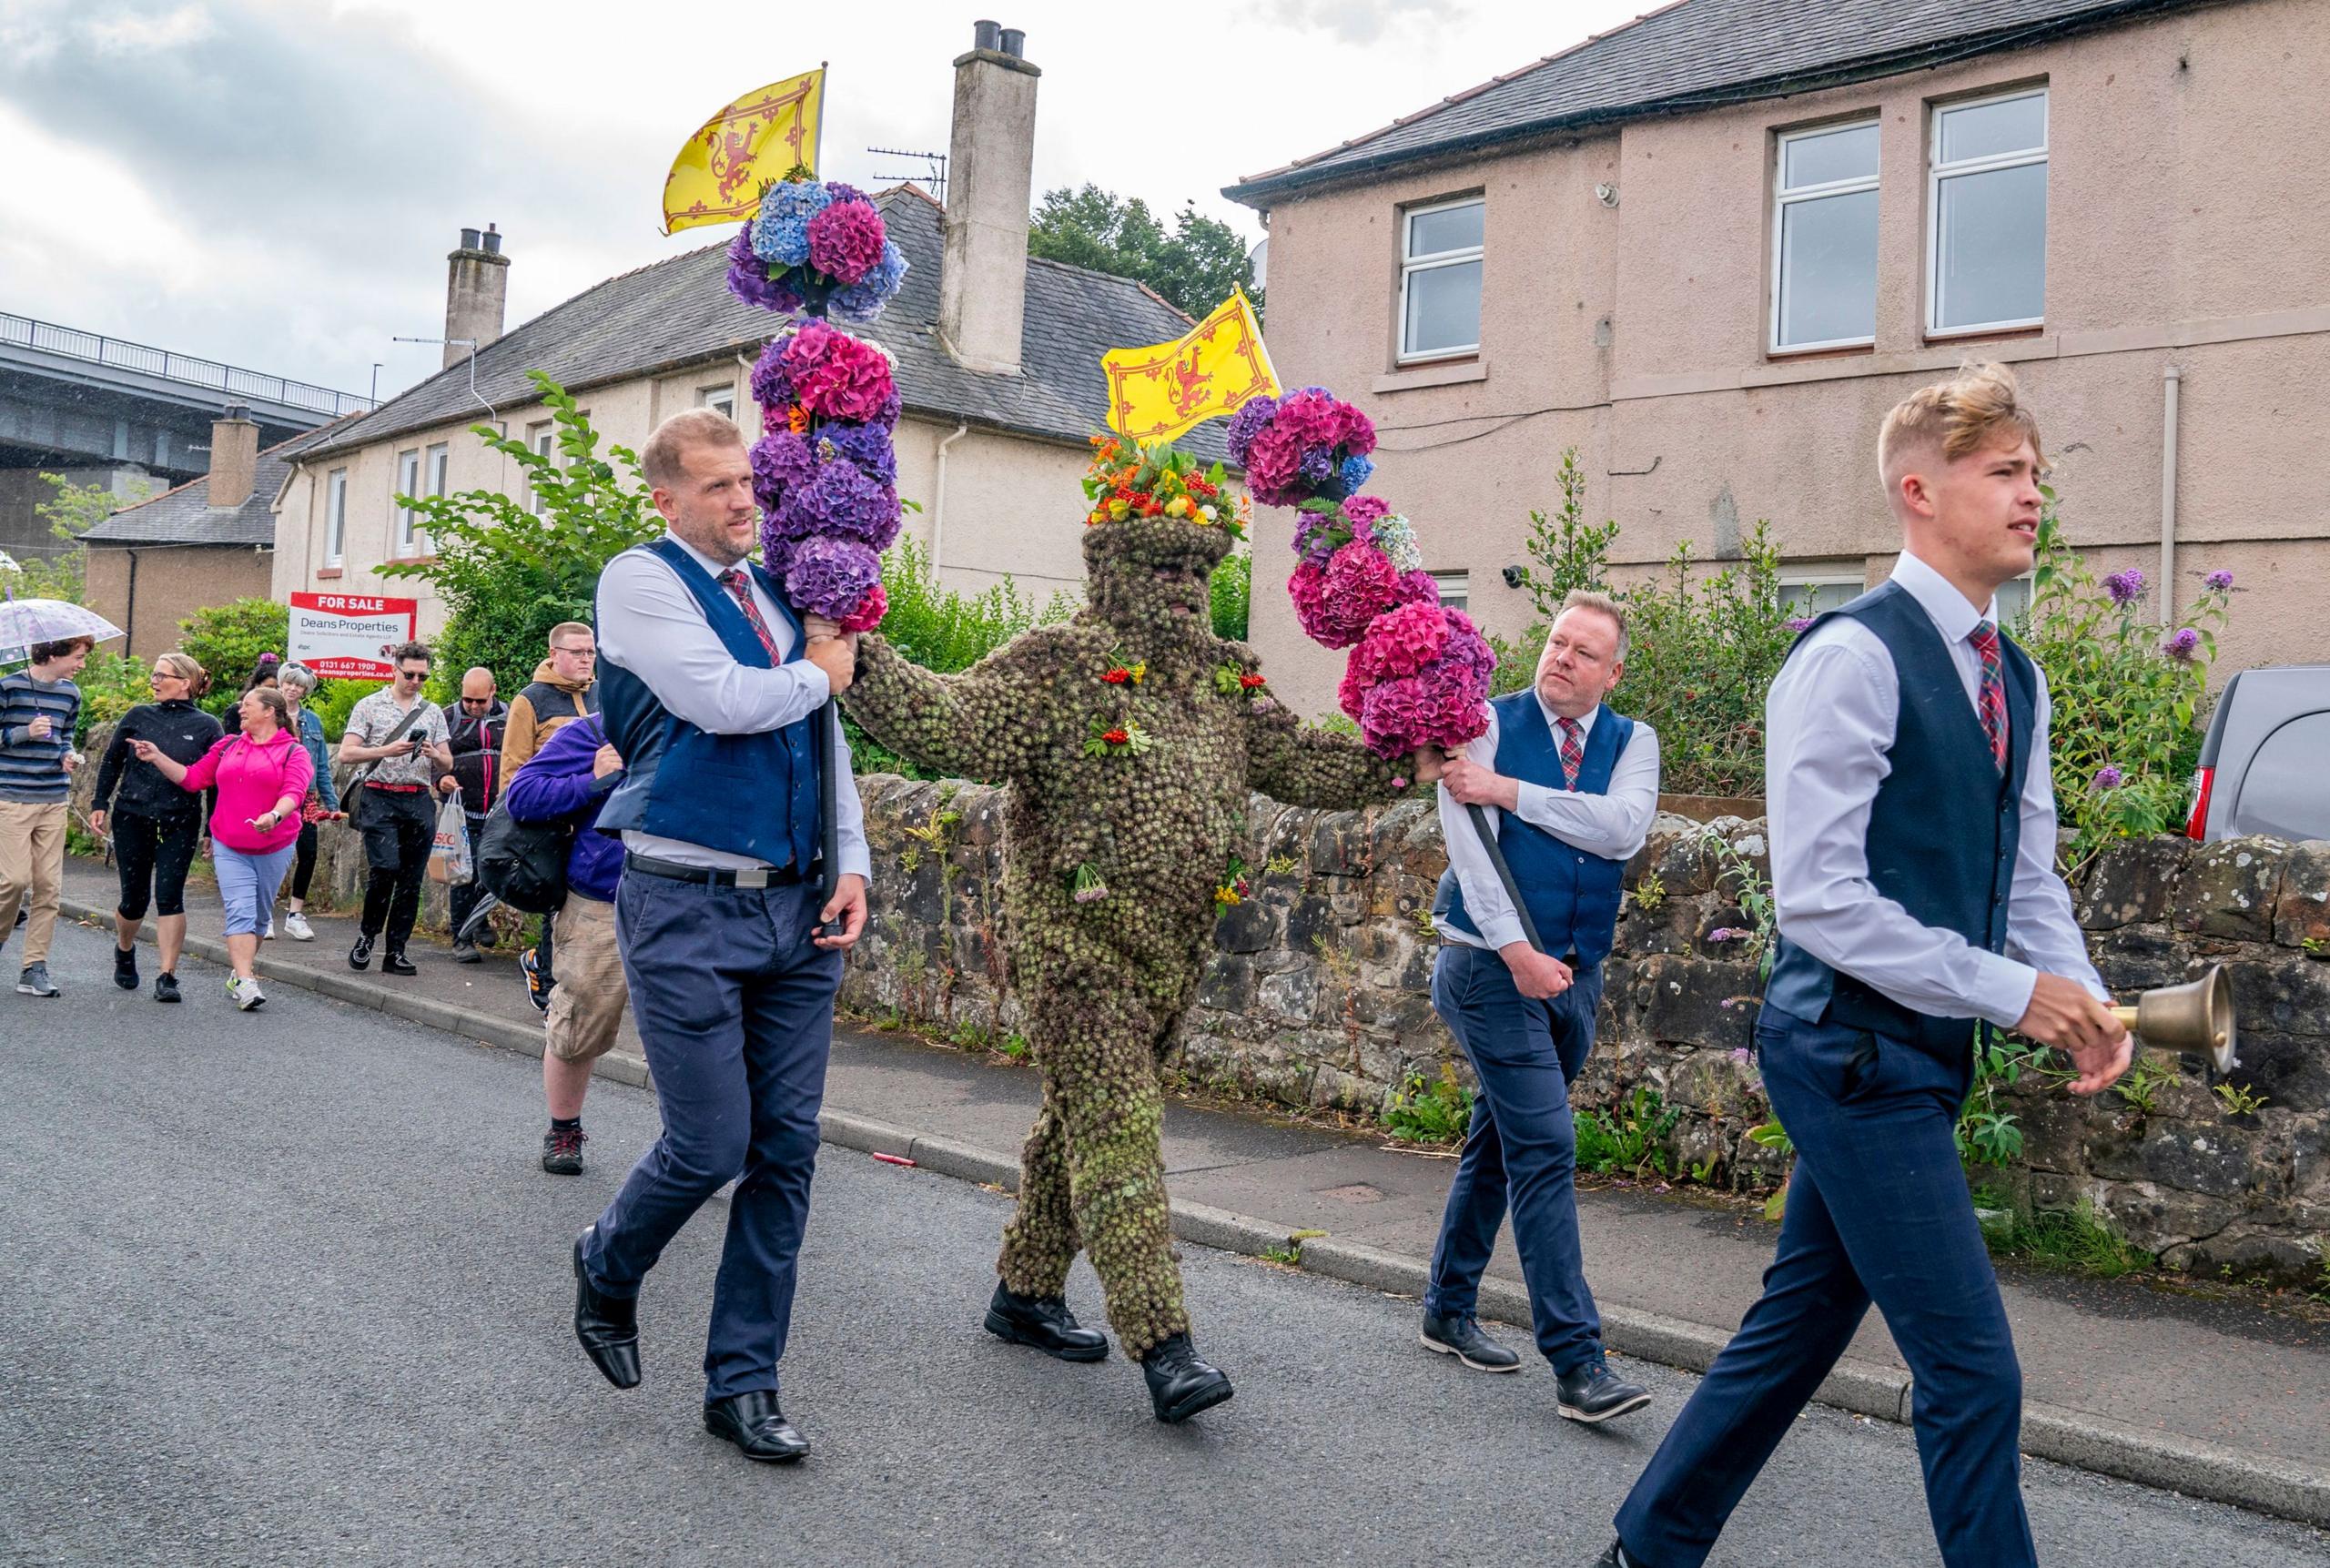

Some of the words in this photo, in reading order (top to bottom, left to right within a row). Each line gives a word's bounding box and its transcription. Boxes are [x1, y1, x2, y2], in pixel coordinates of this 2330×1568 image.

[318, 596, 345, 609] FOR
[349, 599, 384, 611] SALE
[300, 617, 337, 629] Deans
[339, 619, 399, 632] Properties
[319, 661, 338, 669] 0131
[340, 662, 355, 670] 667
[358, 663, 376, 671] 1900
[312, 669, 393, 678] w.deansproperties.co.uk
[434, 832, 456, 845] SCO
